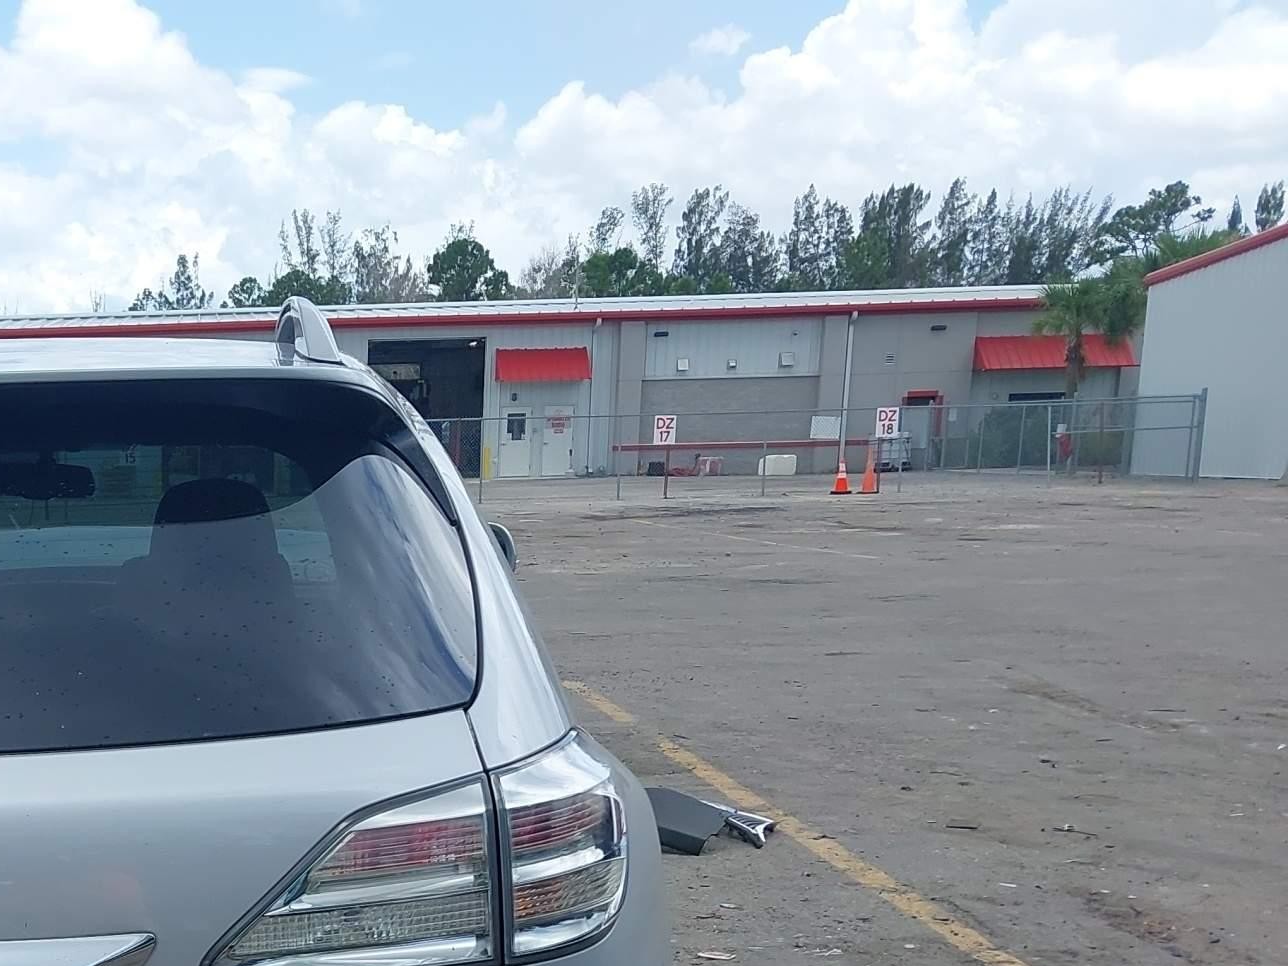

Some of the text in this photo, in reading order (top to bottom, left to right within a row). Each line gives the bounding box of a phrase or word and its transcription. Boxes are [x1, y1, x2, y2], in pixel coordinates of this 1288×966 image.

[878, 410, 897, 422] DZ
[656, 417, 675, 430] DZ
[882, 423, 894, 435] 18
[659, 430, 671, 442] 17
